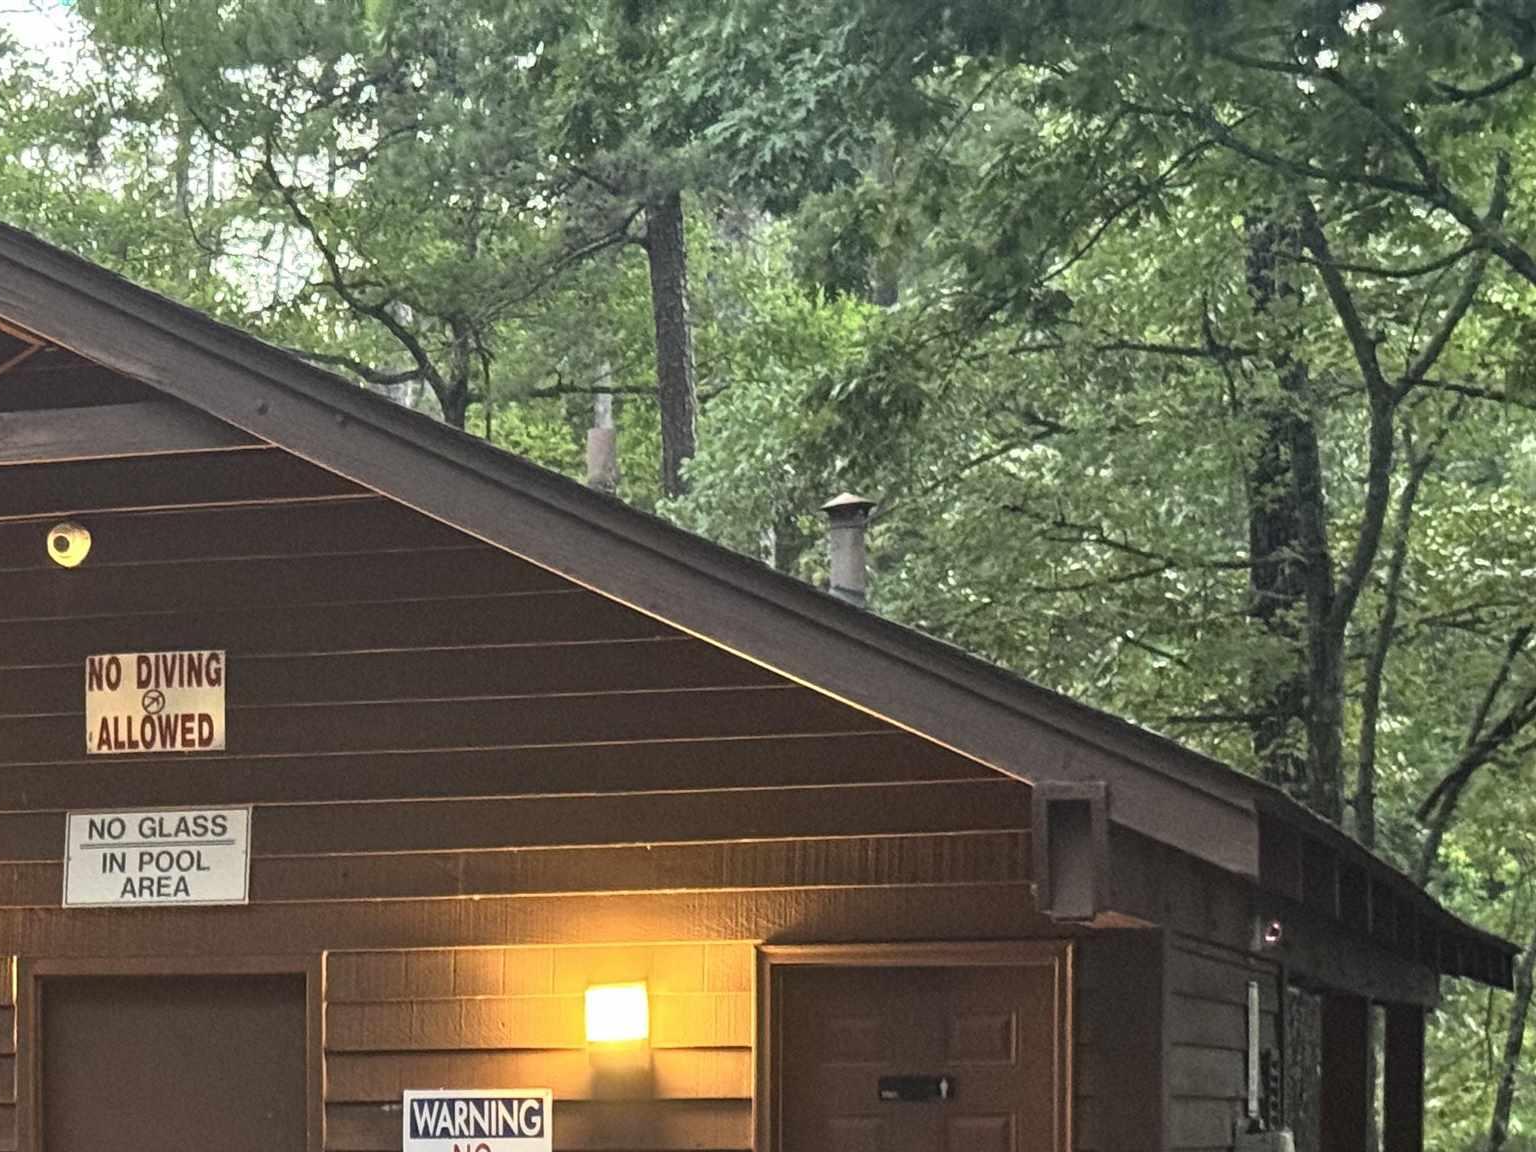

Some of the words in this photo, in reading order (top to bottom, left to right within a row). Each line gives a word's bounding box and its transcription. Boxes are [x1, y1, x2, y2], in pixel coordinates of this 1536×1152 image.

[88, 656, 122, 691] NO
[136, 652, 222, 689] DIVING
[97, 713, 214, 751] ALLOWED
[88, 817, 126, 841] NO
[138, 814, 228, 838] GLASS
[101, 851, 126, 874] IN
[138, 850, 210, 873] POOL
[120, 876, 190, 898] AREA
[412, 1098, 542, 1137] WARNING
